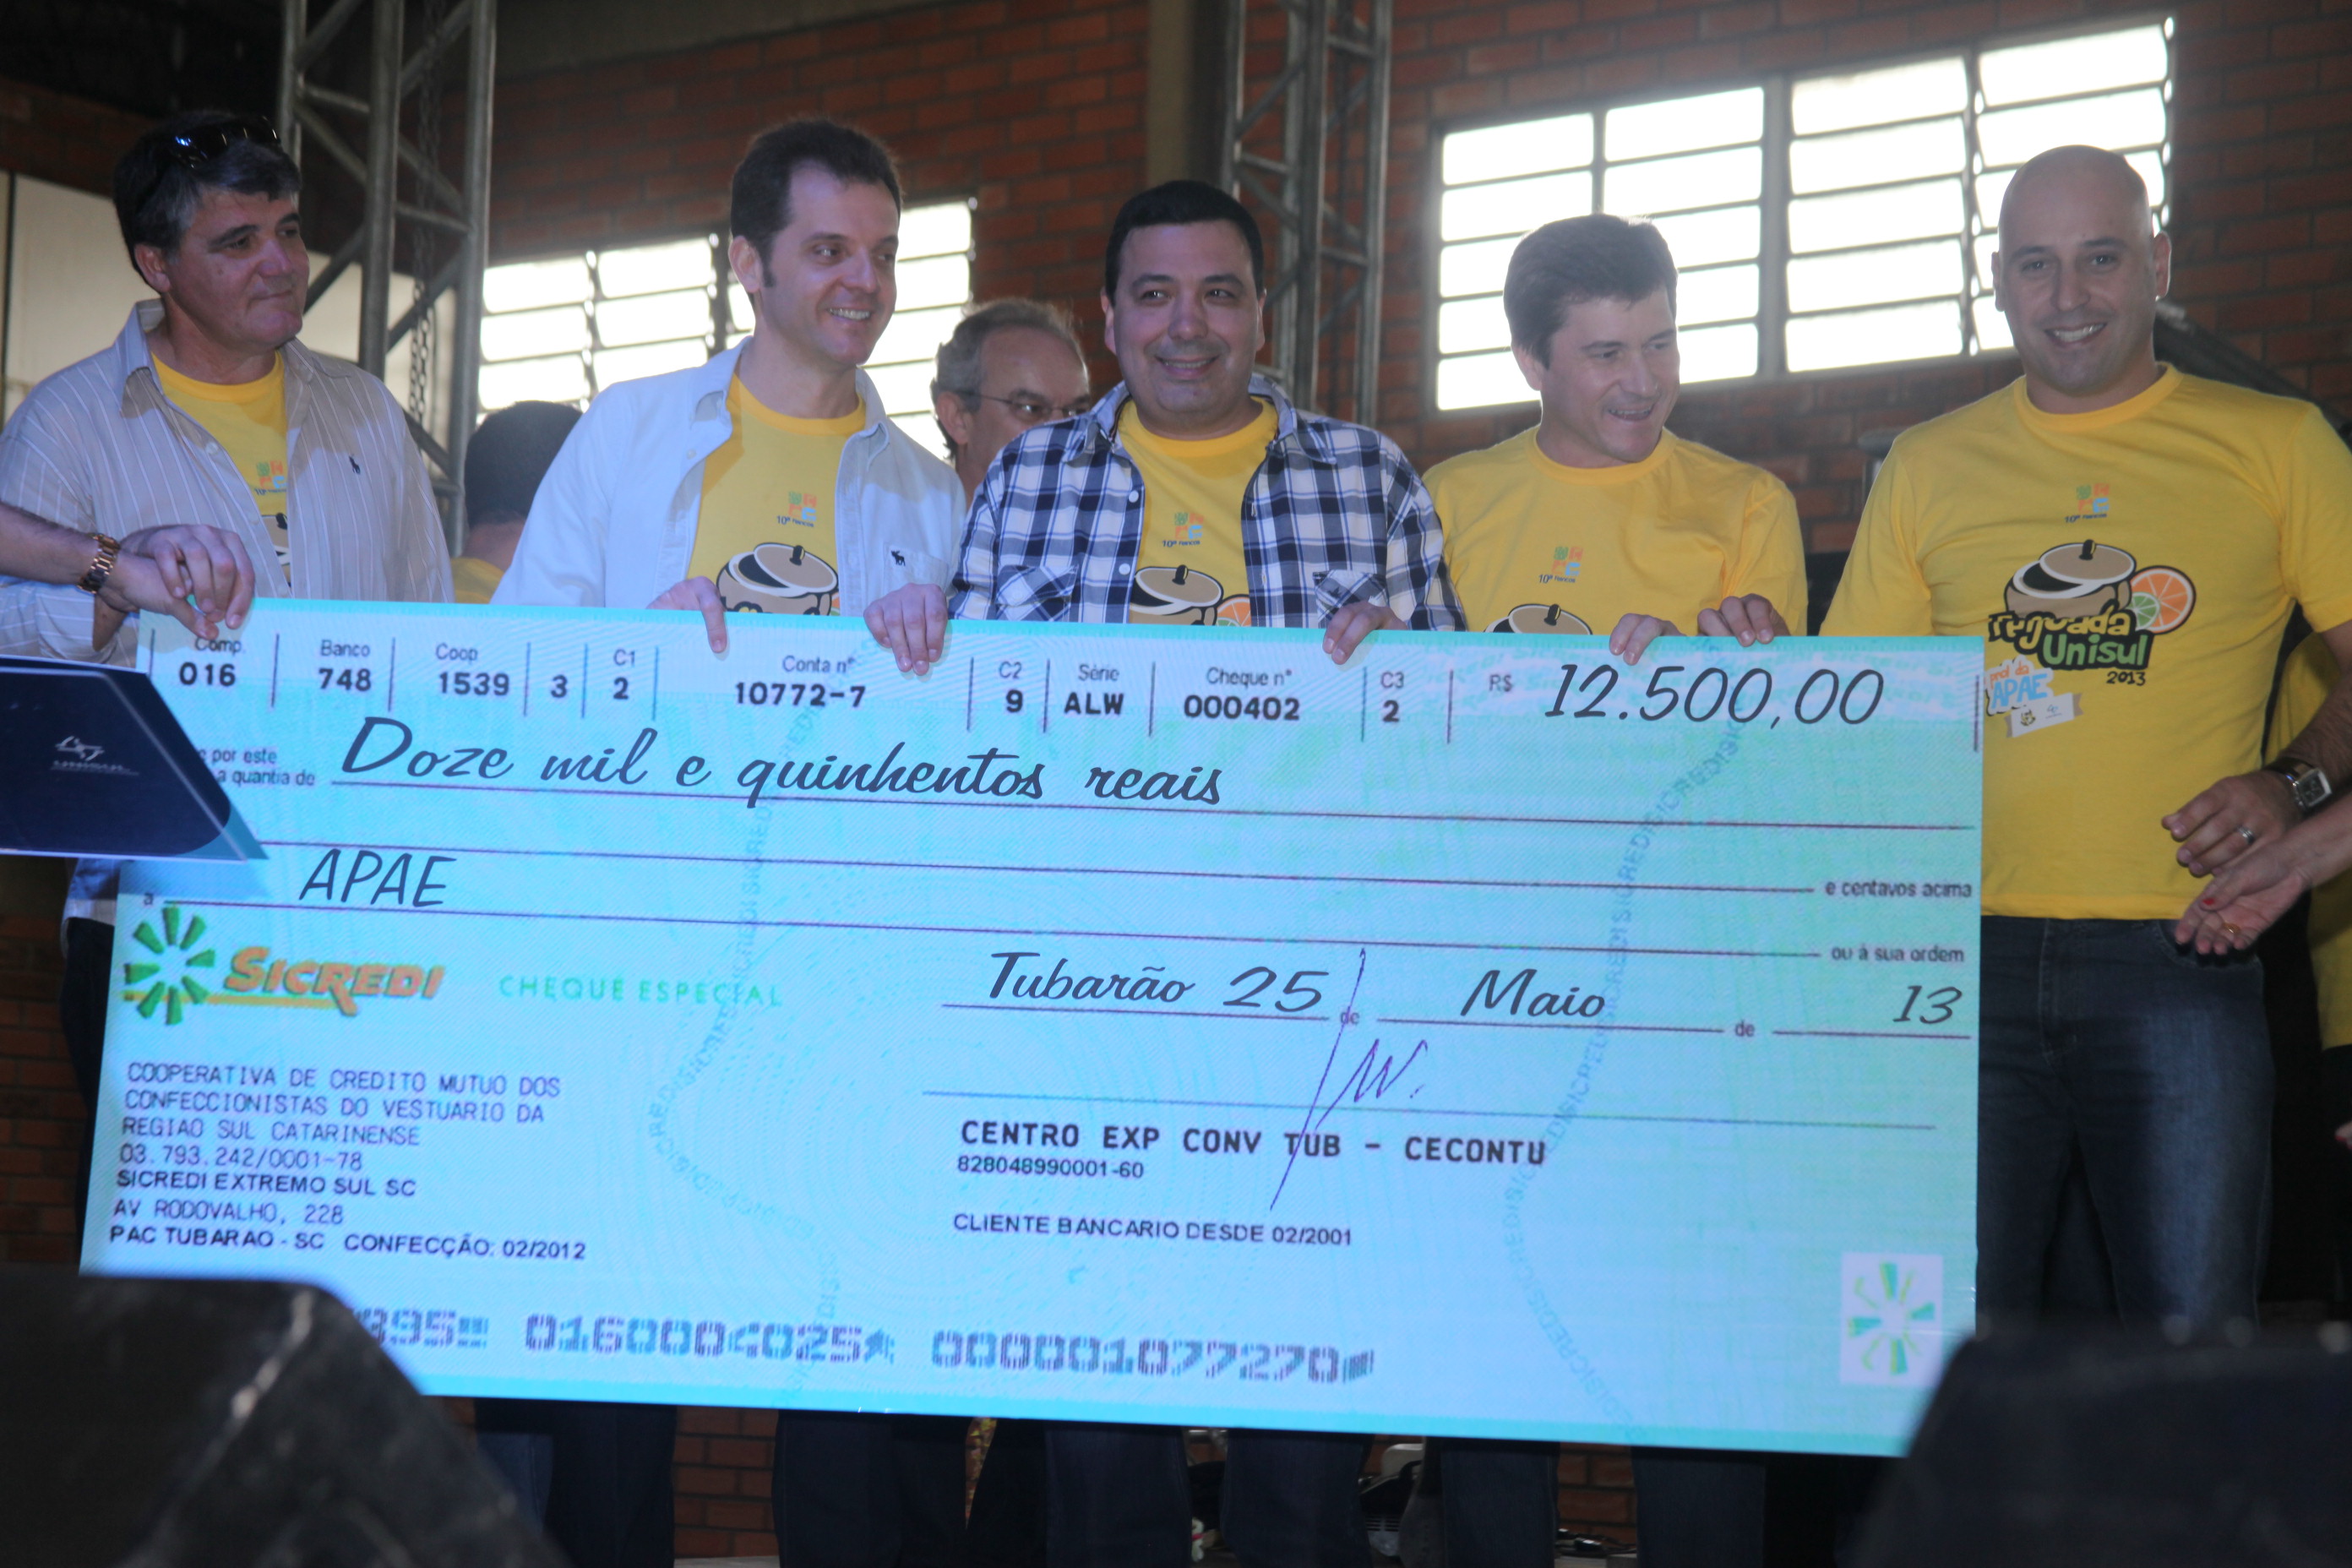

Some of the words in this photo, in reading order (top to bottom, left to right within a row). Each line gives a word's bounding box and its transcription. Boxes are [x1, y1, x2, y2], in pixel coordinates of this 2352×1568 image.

[321, 640, 370, 658] Banco
[436, 644, 477, 663] Coop
[613, 649, 636, 667] C1
[2043, 634, 2148, 666] Unisul
[179, 662, 236, 686] 016
[783, 655, 830, 672] Conta
[999, 662, 1022, 680] C2
[1078, 664, 1119, 683] Série
[2015, 661, 2029, 675] da
[318, 668, 372, 691] 748
[438, 672, 510, 696] 1539
[550, 676, 568, 699] 3
[613, 678, 629, 700] 2
[1206, 667, 1268, 689] Cheque
[1381, 672, 1404, 689] C3
[2106, 672, 2146, 686] 2013
[736, 680, 866, 707] 10772-7
[1005, 690, 1024, 713] 9
[1489, 673, 1512, 694] R$
[1545, 664, 1883, 729] 12.500,00
[1991, 673, 2048, 709] APAE
[1064, 693, 1124, 716] ALW
[1184, 694, 1300, 721] 000402
[1382, 700, 1400, 724] 2
[212, 749, 236, 764] por
[243, 749, 277, 764] este
[232, 770, 290, 787] quantia
[296, 770, 315, 786] de
[341, 716, 514, 779] Doze
[541, 727, 658, 785] mil
[676, 755, 711, 787] e
[737, 743, 1045, 808] quinhentos
[1083, 764, 1222, 805] reais
[299, 848, 457, 907] APAE
[1825, 881, 1835, 896] e
[1842, 880, 1916, 896] centavos
[1922, 882, 1972, 897] acima
[1832, 948, 1853, 961] ou
[1875, 949, 1904, 961] sua
[1910, 945, 1964, 962] ordem
[499, 976, 625, 1001] CHEQUE
[639, 979, 782, 1007] ESPECIAL
[989, 951, 1196, 1002] Tubarão
[1222, 966, 1330, 1012] 25
[1460, 968, 1605, 1018] Maio
[1734, 1020, 1755, 1037] de
[1892, 985, 1963, 1025] 13
[128, 1063, 277, 1086] COOPERATIVA
[290, 1069, 317, 1088] DE
[329, 1070, 427, 1092] CREDITO
[438, 1075, 508, 1095] MUTUO
[519, 1076, 562, 1097] DOS
[125, 1090, 329, 1116] CONFECCIONISTAS
[340, 1098, 368, 1118] DO
[383, 1099, 504, 1122] VESTUARIO
[516, 1103, 545, 1124] DA
[122, 1117, 204, 1137] REGIAO
[217, 1119, 256, 1139] SUL
[271, 1123, 421, 1146] CATARINENSE
[961, 1120, 1080, 1147] CENTRO
[1102, 1125, 1160, 1150] EXP
[1183, 1128, 1262, 1153] CONV
[1284, 1132, 1342, 1157] TUB
[1404, 1137, 1545, 1166] CECONTU
[120, 1144, 362, 1171] 03.793.242/0001-78
[957, 1156, 1144, 1179] 828048990001-60
[117, 1170, 208, 1190] SICREDI
[215, 1173, 326, 1194] EXTREMO
[334, 1177, 376, 1195] SUL
[386, 1179, 416, 1196] SC
[113, 1199, 141, 1217] AV
[155, 1198, 286, 1225] RODOVALHO,
[304, 1204, 343, 1224] 228
[953, 1213, 1050, 1234] CLIENTE
[1058, 1217, 1179, 1239] BANCARIO
[1185, 1222, 1264, 1243] DESDE
[1272, 1226, 1352, 1246] 02/2001
[110, 1227, 156, 1244] PAC
[166, 1228, 274, 1248] TUBARAO
[295, 1233, 324, 1250] SC
[344, 1232, 495, 1258] CONFECÇÃO:
[503, 1240, 586, 1260] 02/2012
